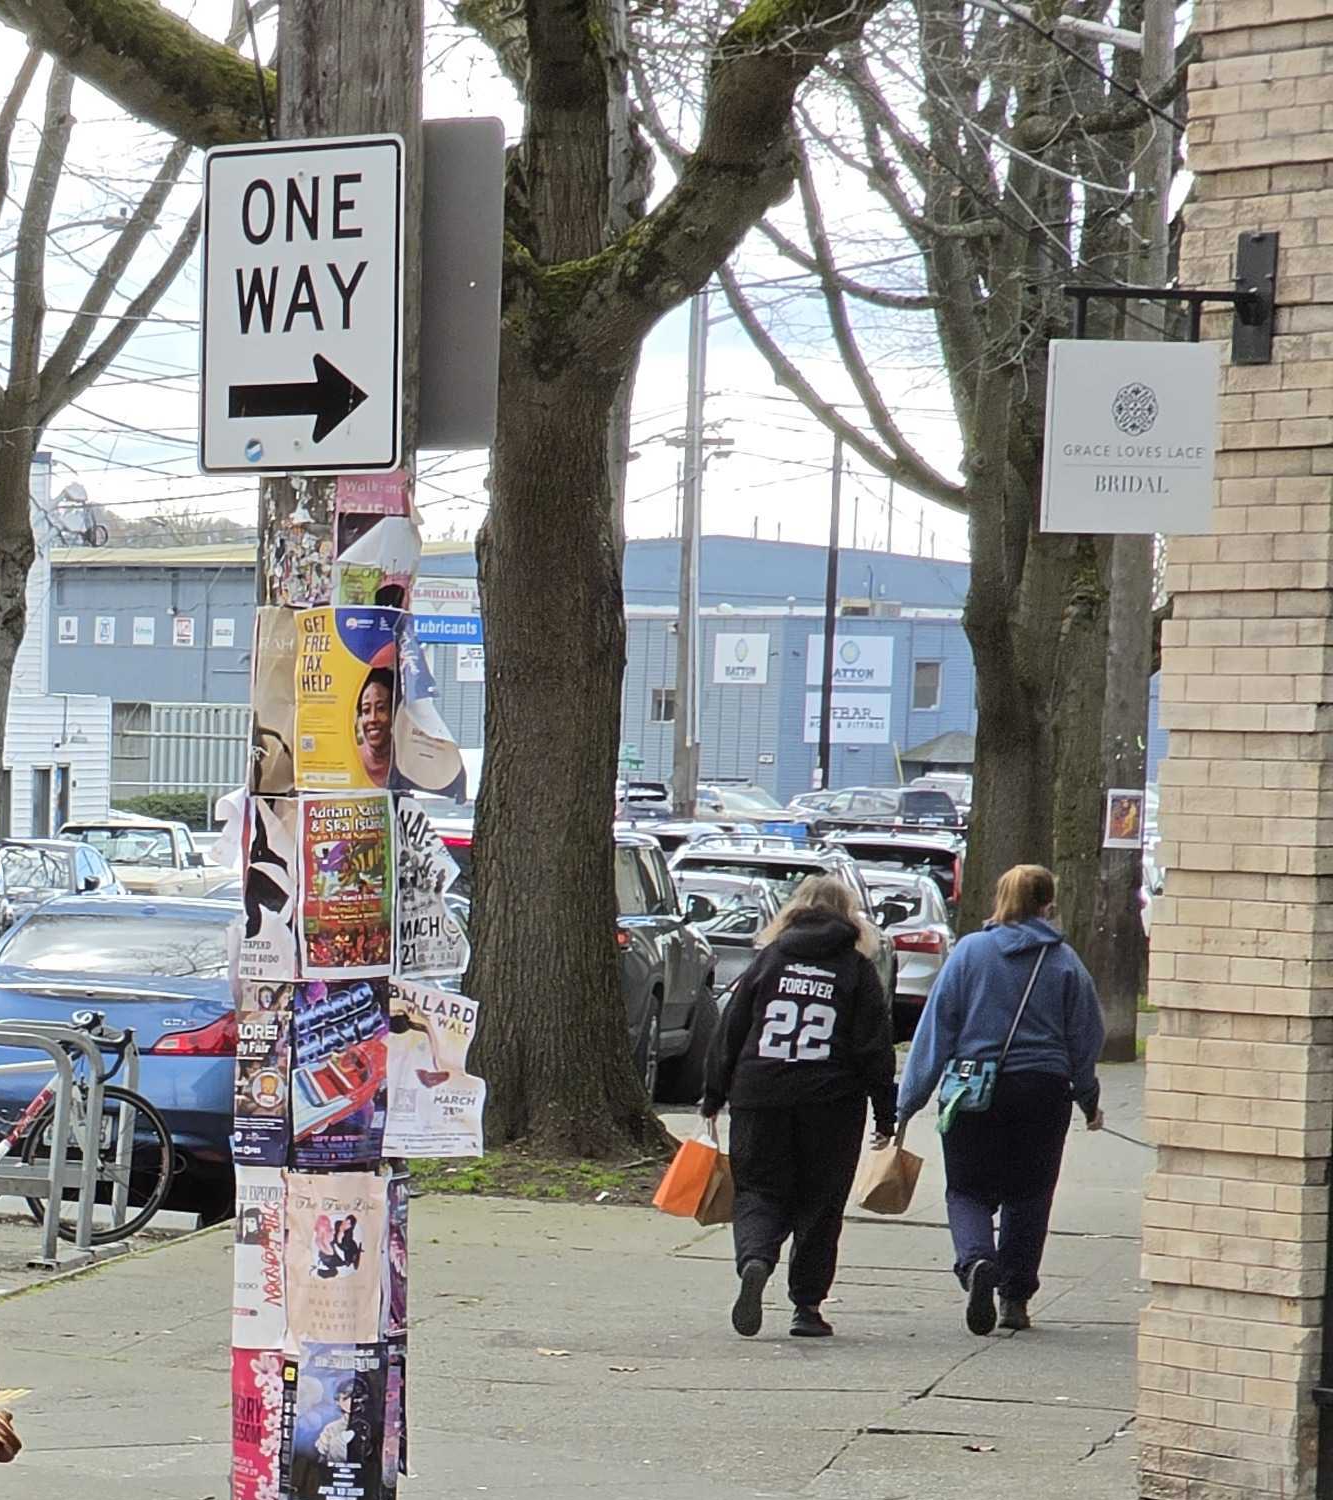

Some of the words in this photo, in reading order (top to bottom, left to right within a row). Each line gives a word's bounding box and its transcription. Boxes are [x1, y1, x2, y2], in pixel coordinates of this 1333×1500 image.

[241, 172, 363, 245] ONE
[236, 261, 369, 334] WAY
[1063, 444, 1110, 457] GRACE
[1117, 445, 1162, 459] LOVES
[1167, 447, 1203, 460] LACE
[1095, 475, 1169, 493] BRIDAL
[303, 615, 326, 633] GET
[413, 619, 478, 635] Lubricants
[303, 634, 331, 653] FREE
[302, 654, 321, 672] TAX
[833, 668, 875, 679] ATTON
[301, 674, 332, 692] HELP
[308, 806, 352, 818] Adrian
[310, 820, 319, 832] &
[325, 819, 350, 832] Ska
[778, 977, 834, 999] FOREVER
[437, 1017, 470, 1036] WALK
[759, 1000, 837, 1060] 22
[249, 1041, 271, 1054] Fair
[433, 1096, 477, 1106] MARCH
